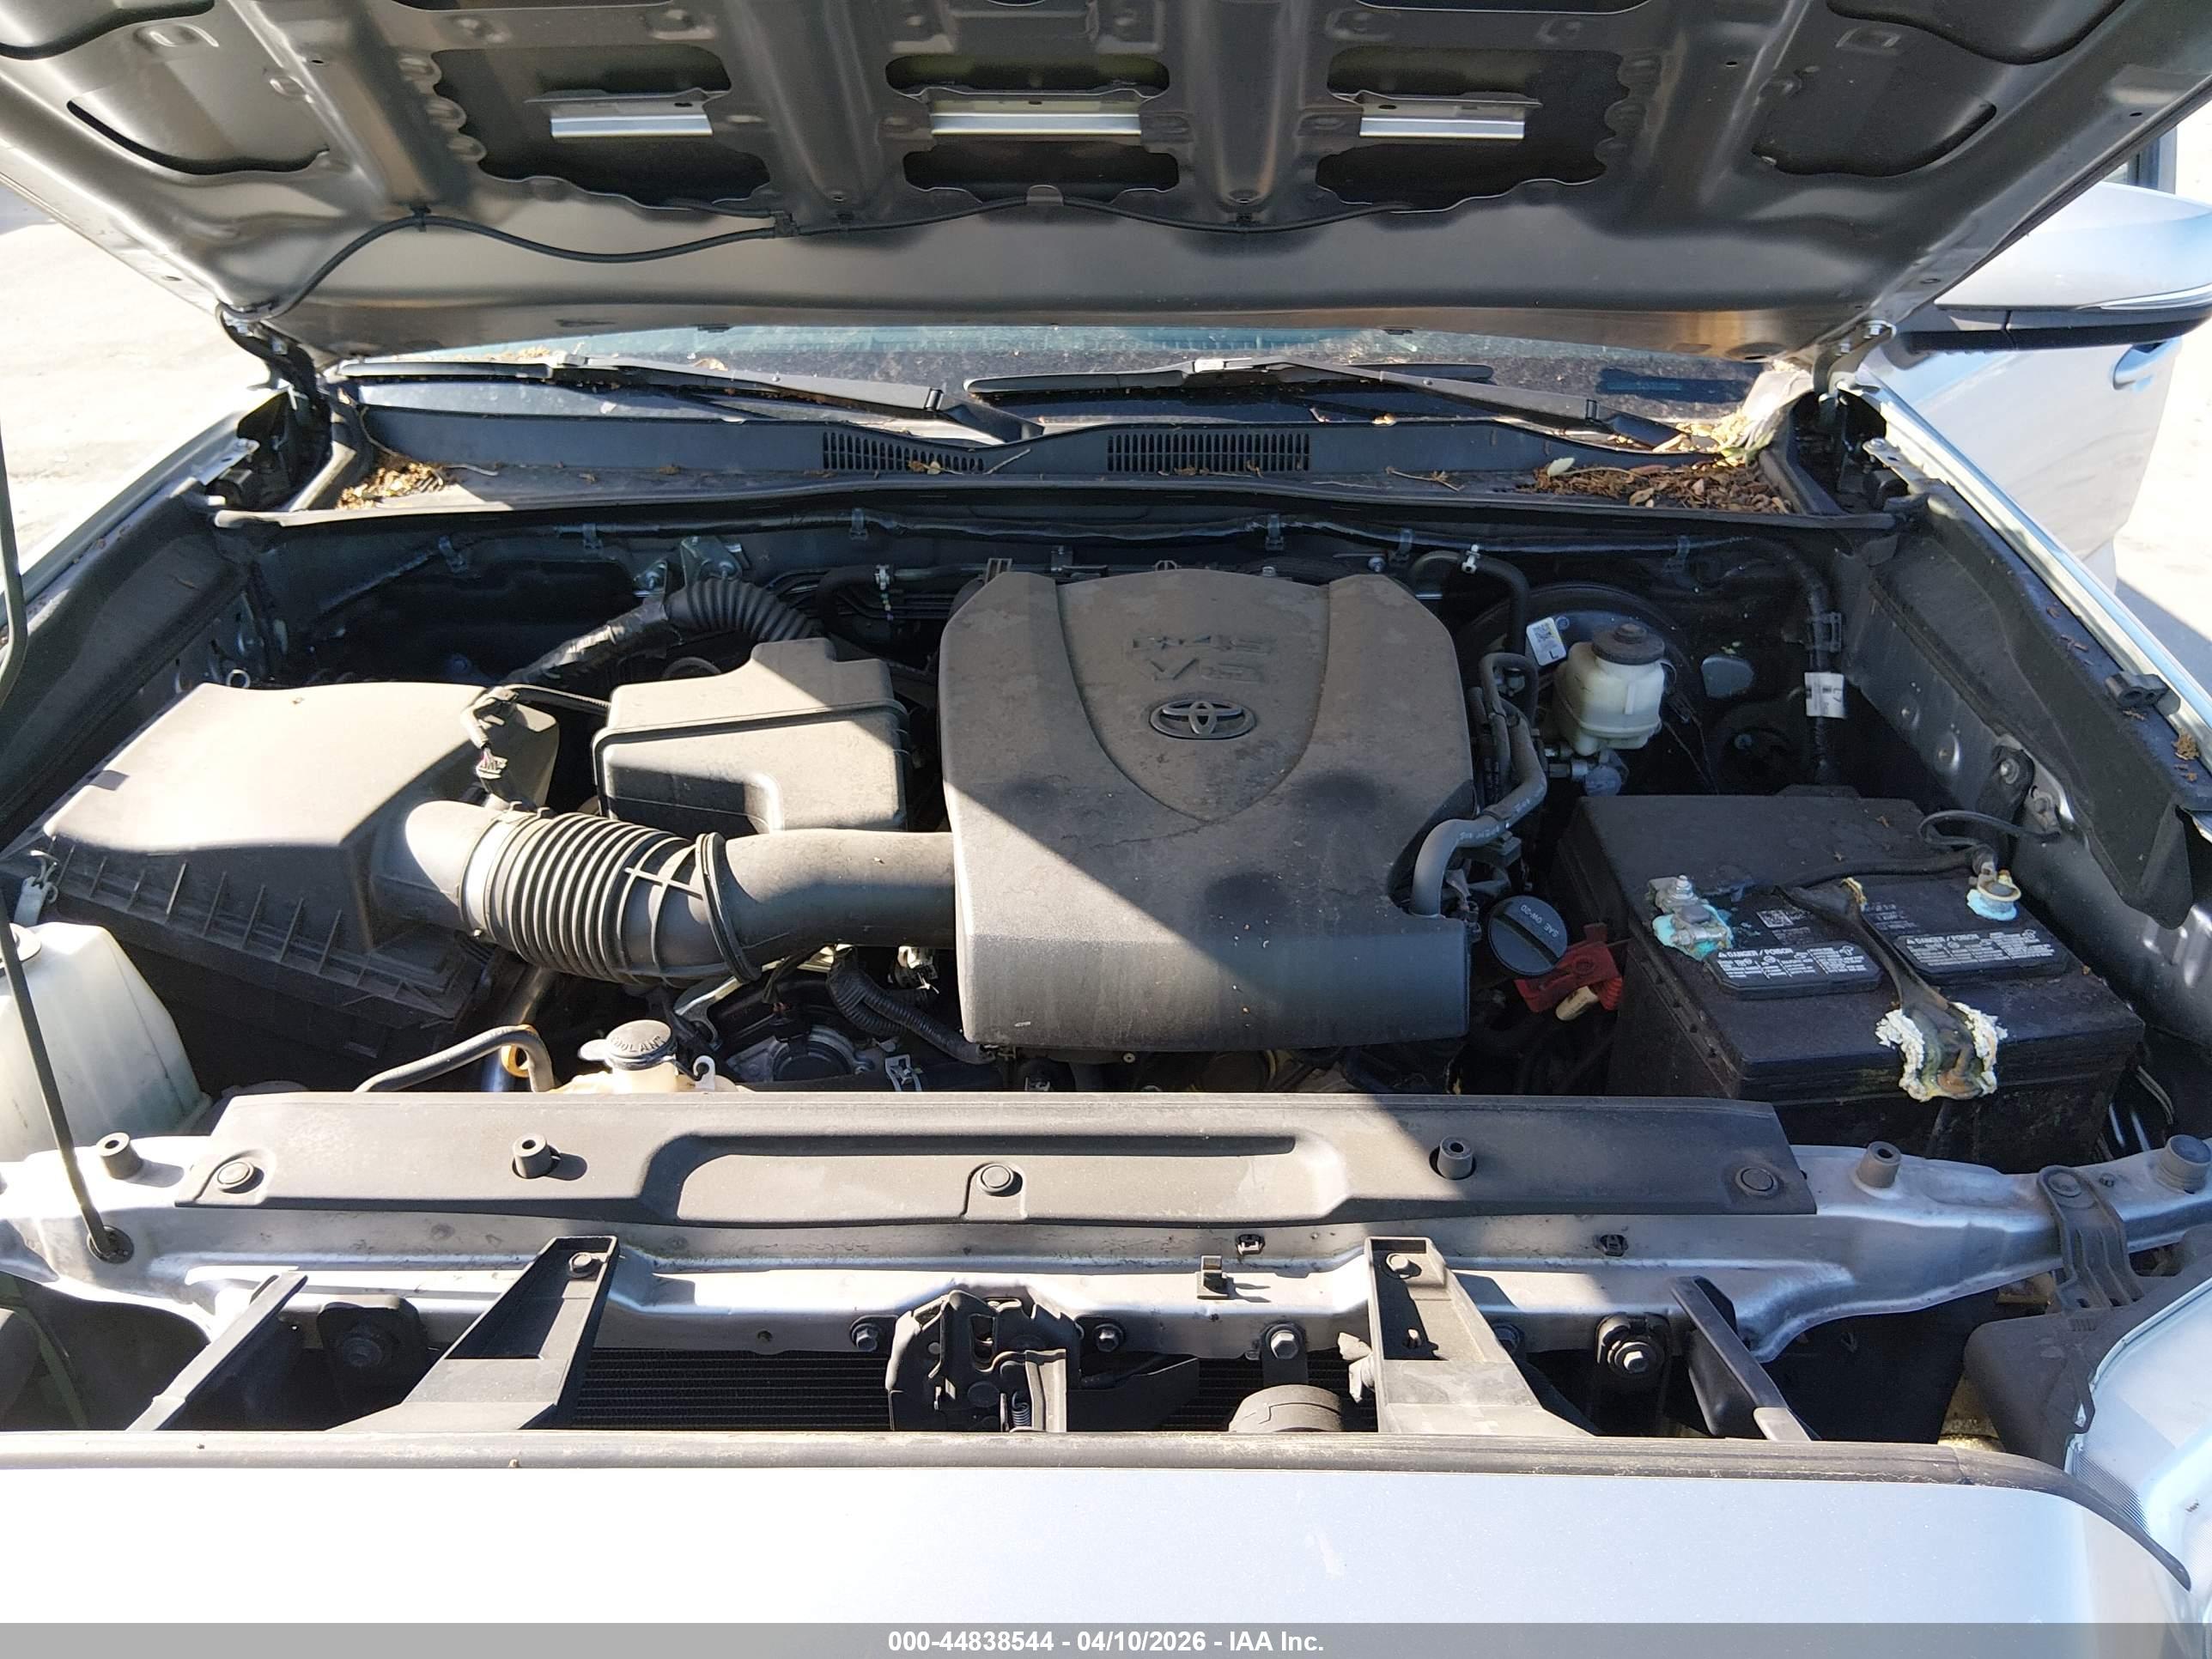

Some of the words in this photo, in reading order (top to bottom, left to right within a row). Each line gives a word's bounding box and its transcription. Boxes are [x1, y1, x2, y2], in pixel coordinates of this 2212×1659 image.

[1521, 904, 1543, 924] 0W-20
[1544, 922, 1559, 938] SAE
[611, 1036, 666, 1053] COOLANT
